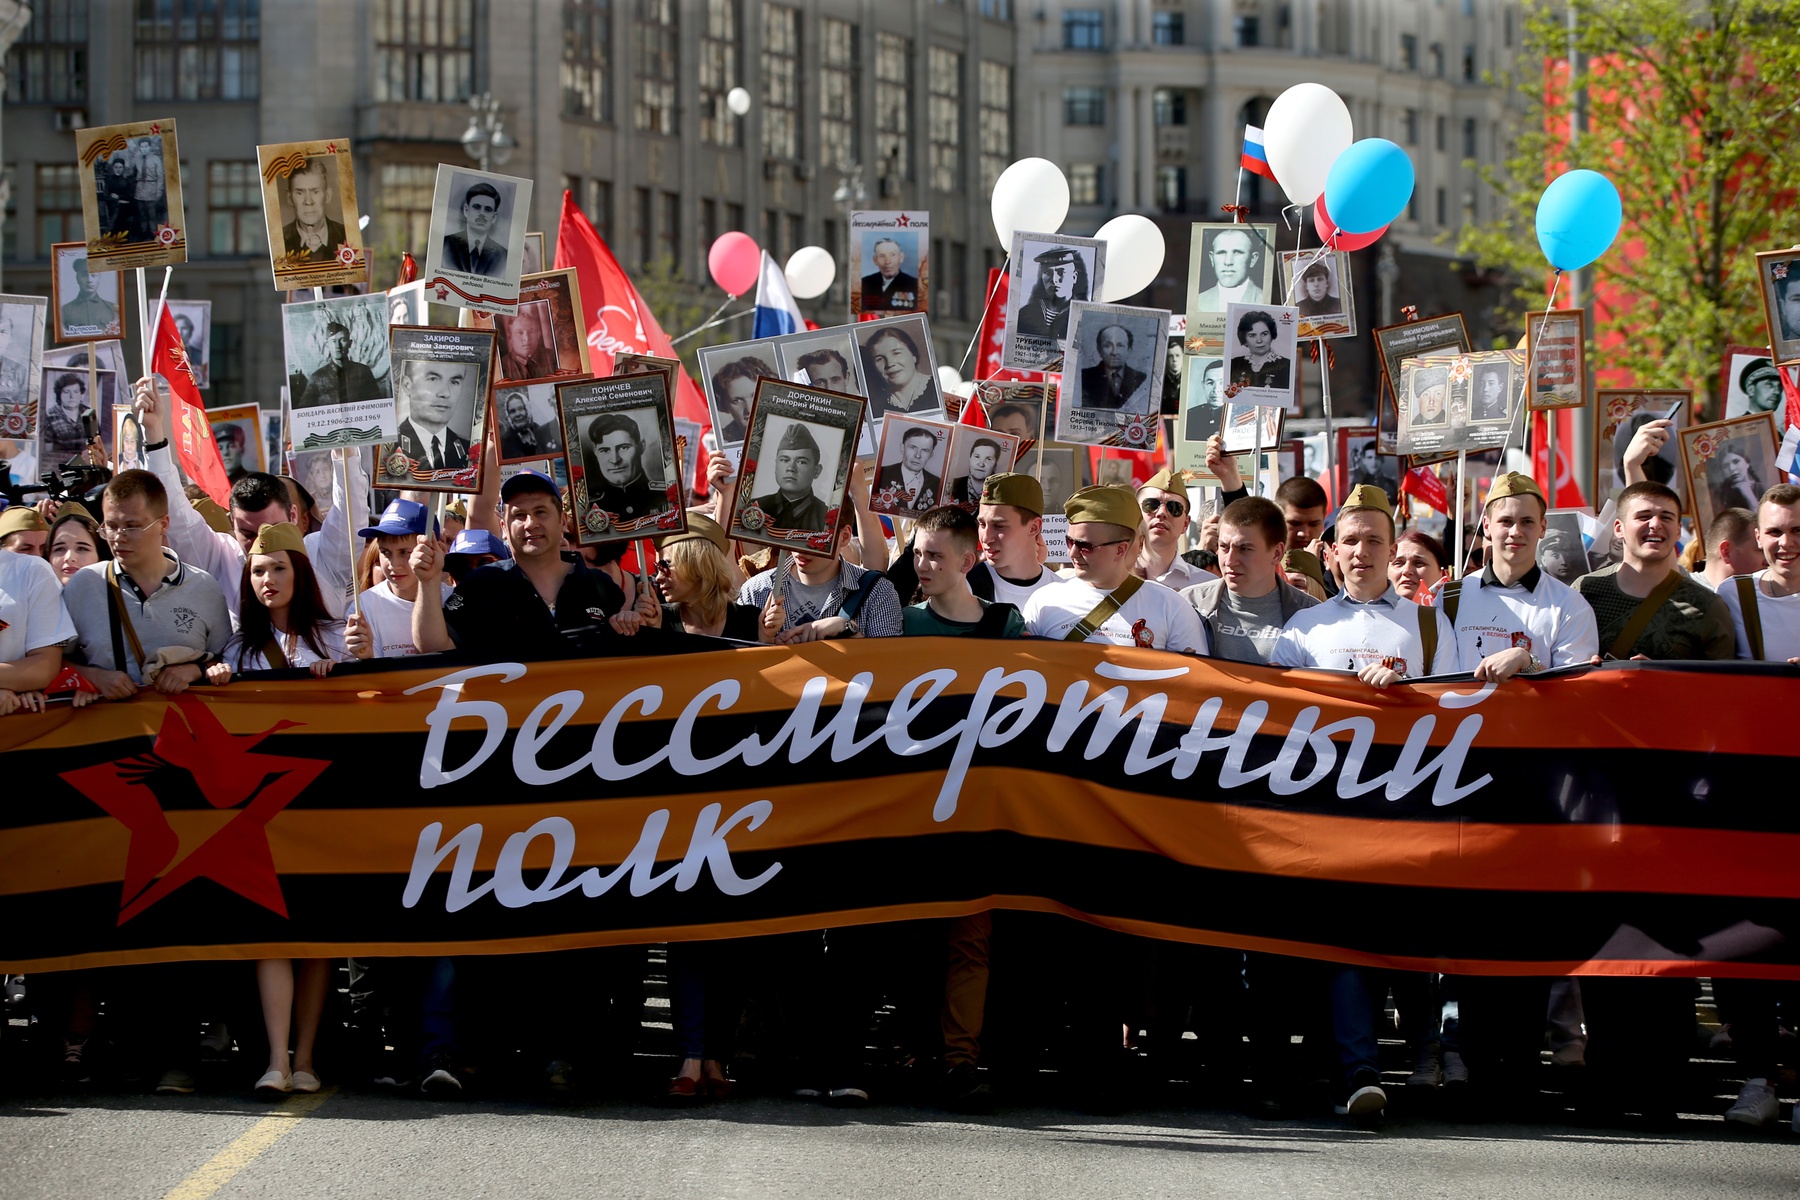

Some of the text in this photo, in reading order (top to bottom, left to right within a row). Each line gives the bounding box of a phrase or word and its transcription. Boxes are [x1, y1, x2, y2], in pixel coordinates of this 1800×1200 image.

[433, 268, 469, 280] Колесниченко
[483, 276, 514, 287] Васильевич
[461, 280, 484, 289] рядовой
[465, 300, 501, 312] Бессмертный
[1402, 323, 1439, 337] ЯКИМОВИЧ
[423, 334, 460, 343] ЗАКИРОВ
[1015, 337, 1052, 347] ТРУБИЦИН
[1389, 328, 1456, 347] Николай Григорьевич
[410, 341, 474, 351] Каюм Закирович
[591, 382, 632, 395] ПОНИЧЕВ
[574, 388, 653, 405] Алексей Семенович
[787, 390, 832, 406] ДОРОНКИН
[297, 402, 393, 419] БОНДАРЬ ВАСИЛИЙ ЕФИМОВИЧ
[772, 395, 847, 417] Григорий Иванович
[1070, 410, 1096, 418] ЯНЦЕВ
[1095, 419, 1119, 428] Тихоно
[1051, 516, 1068, 524] Геор
[1468, 625, 1508, 633] СТАЛИНГРАДА
[403, 663, 1494, 822] Бессмертный
[402, 799, 784, 913] полк
